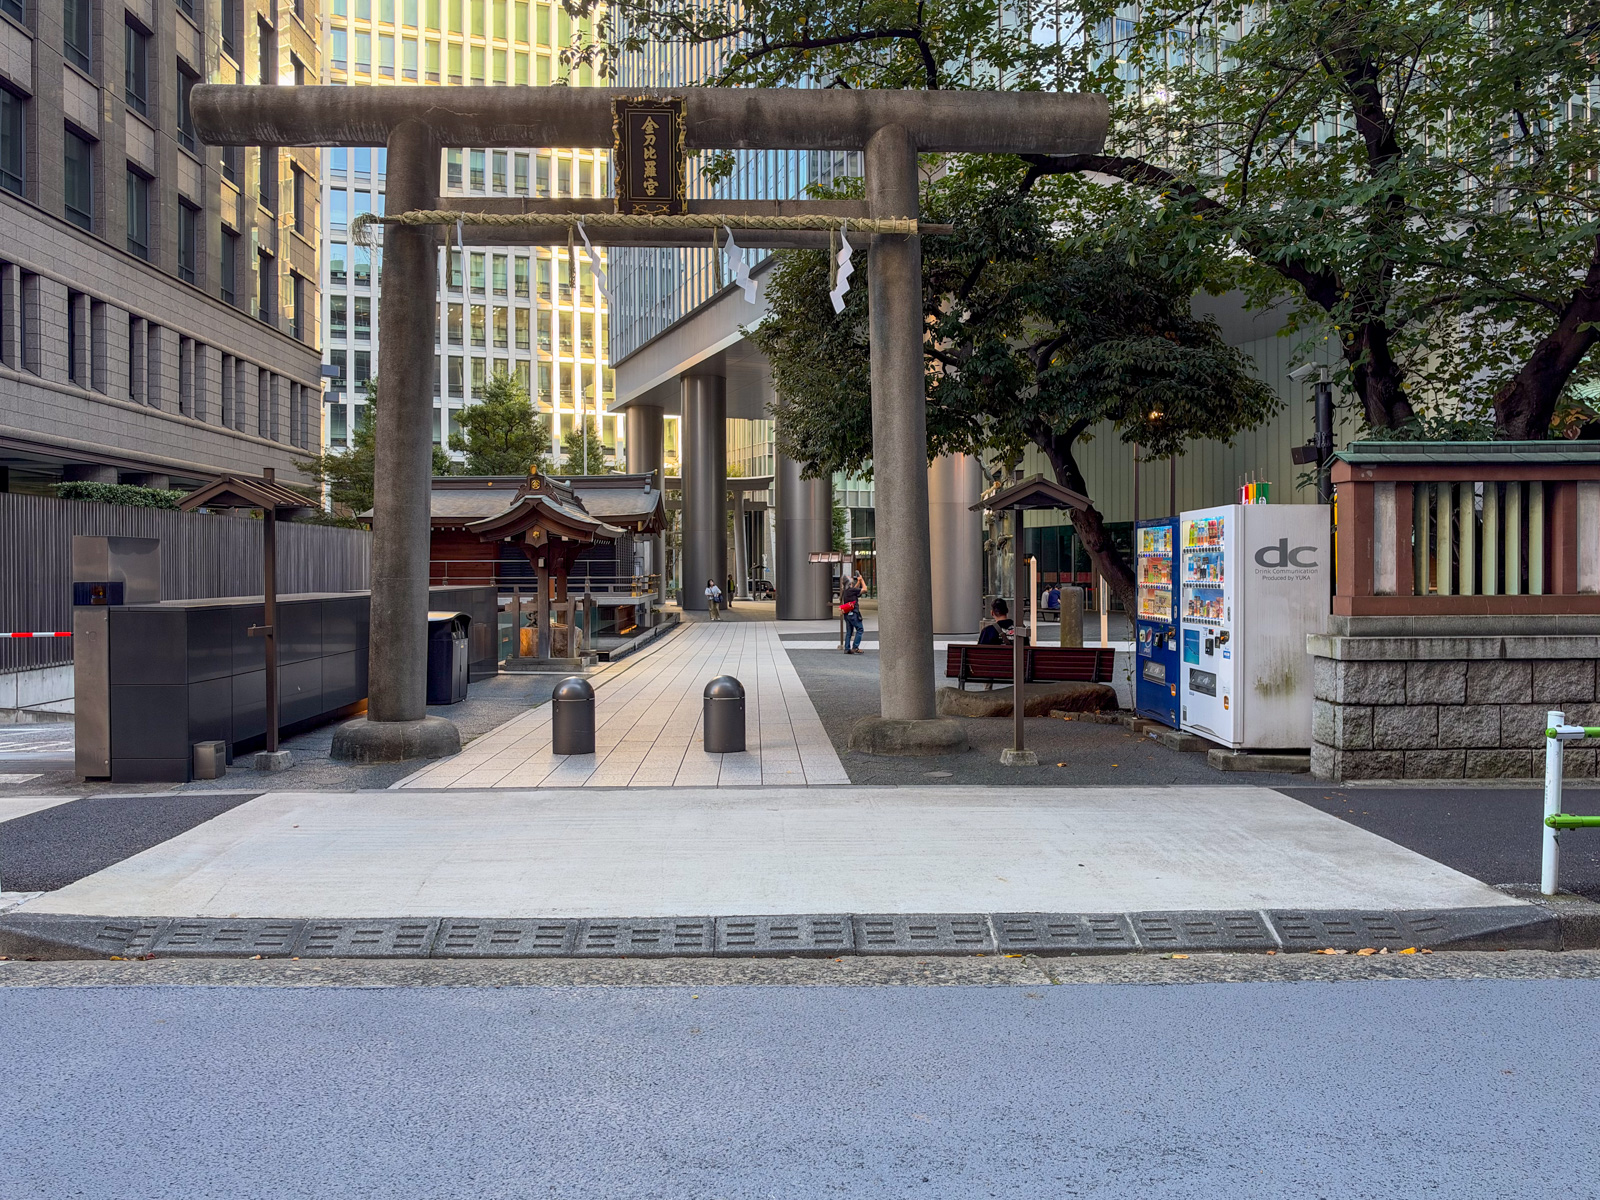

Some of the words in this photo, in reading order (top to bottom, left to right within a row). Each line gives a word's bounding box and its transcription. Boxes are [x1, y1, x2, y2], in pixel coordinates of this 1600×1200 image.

[641, 115, 660, 196] 金刀比羅宮
[1254, 538, 1319, 568] dc
